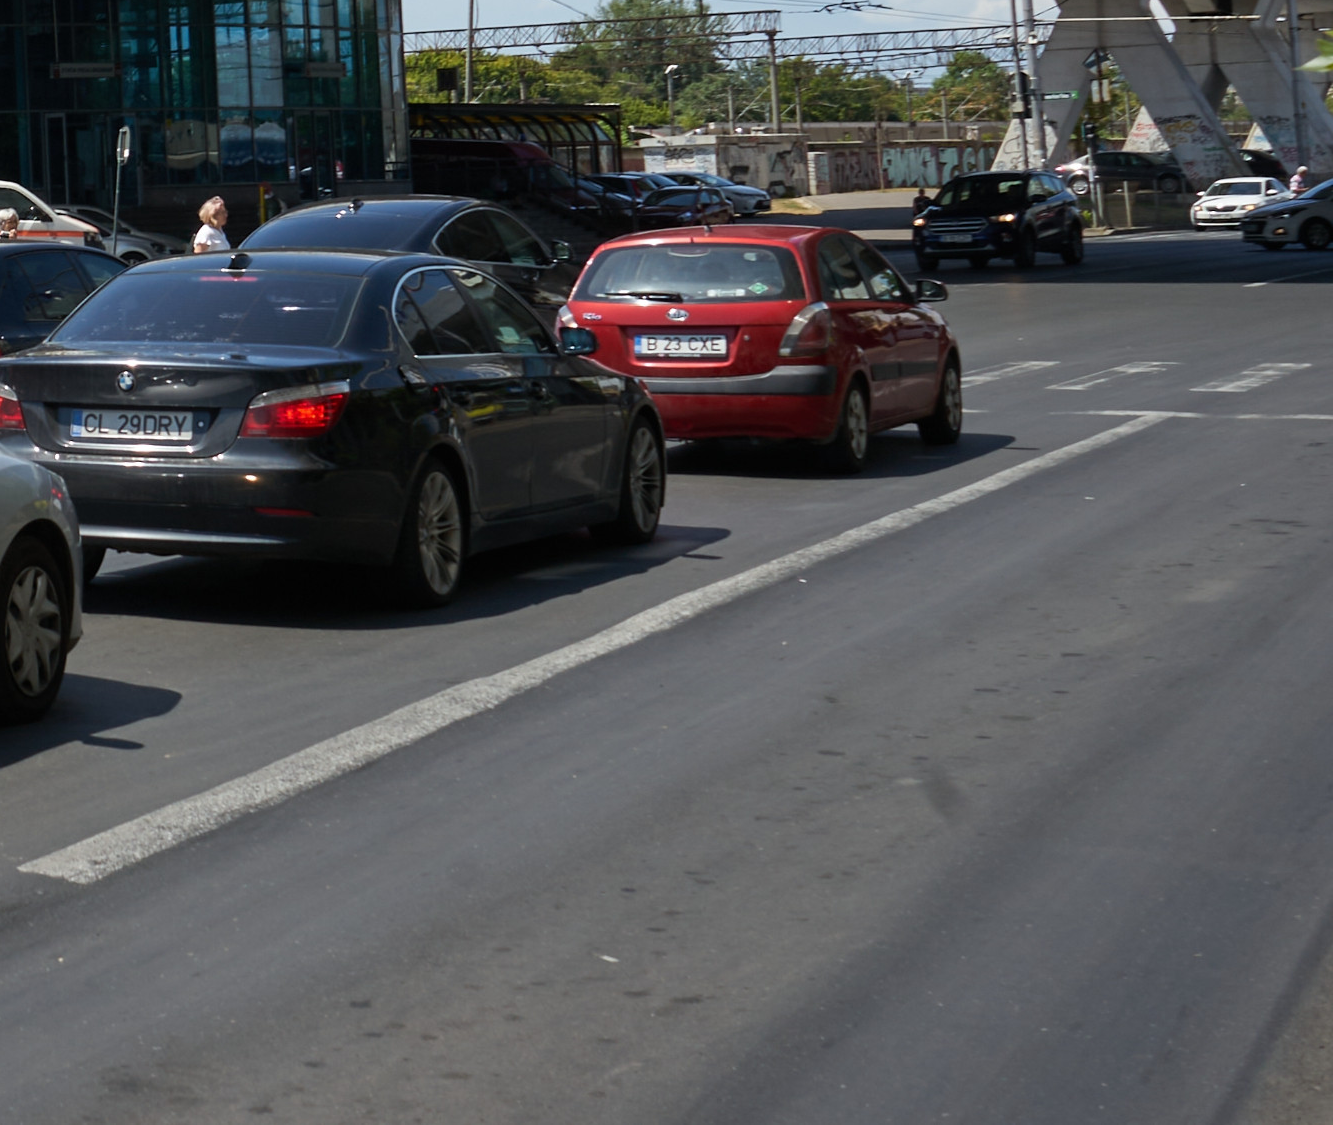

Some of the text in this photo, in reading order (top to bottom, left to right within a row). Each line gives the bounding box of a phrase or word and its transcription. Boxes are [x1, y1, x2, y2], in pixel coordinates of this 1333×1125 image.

[646, 337, 722, 351] B 23 CXE
[84, 413, 188, 437] CL 29DRY
